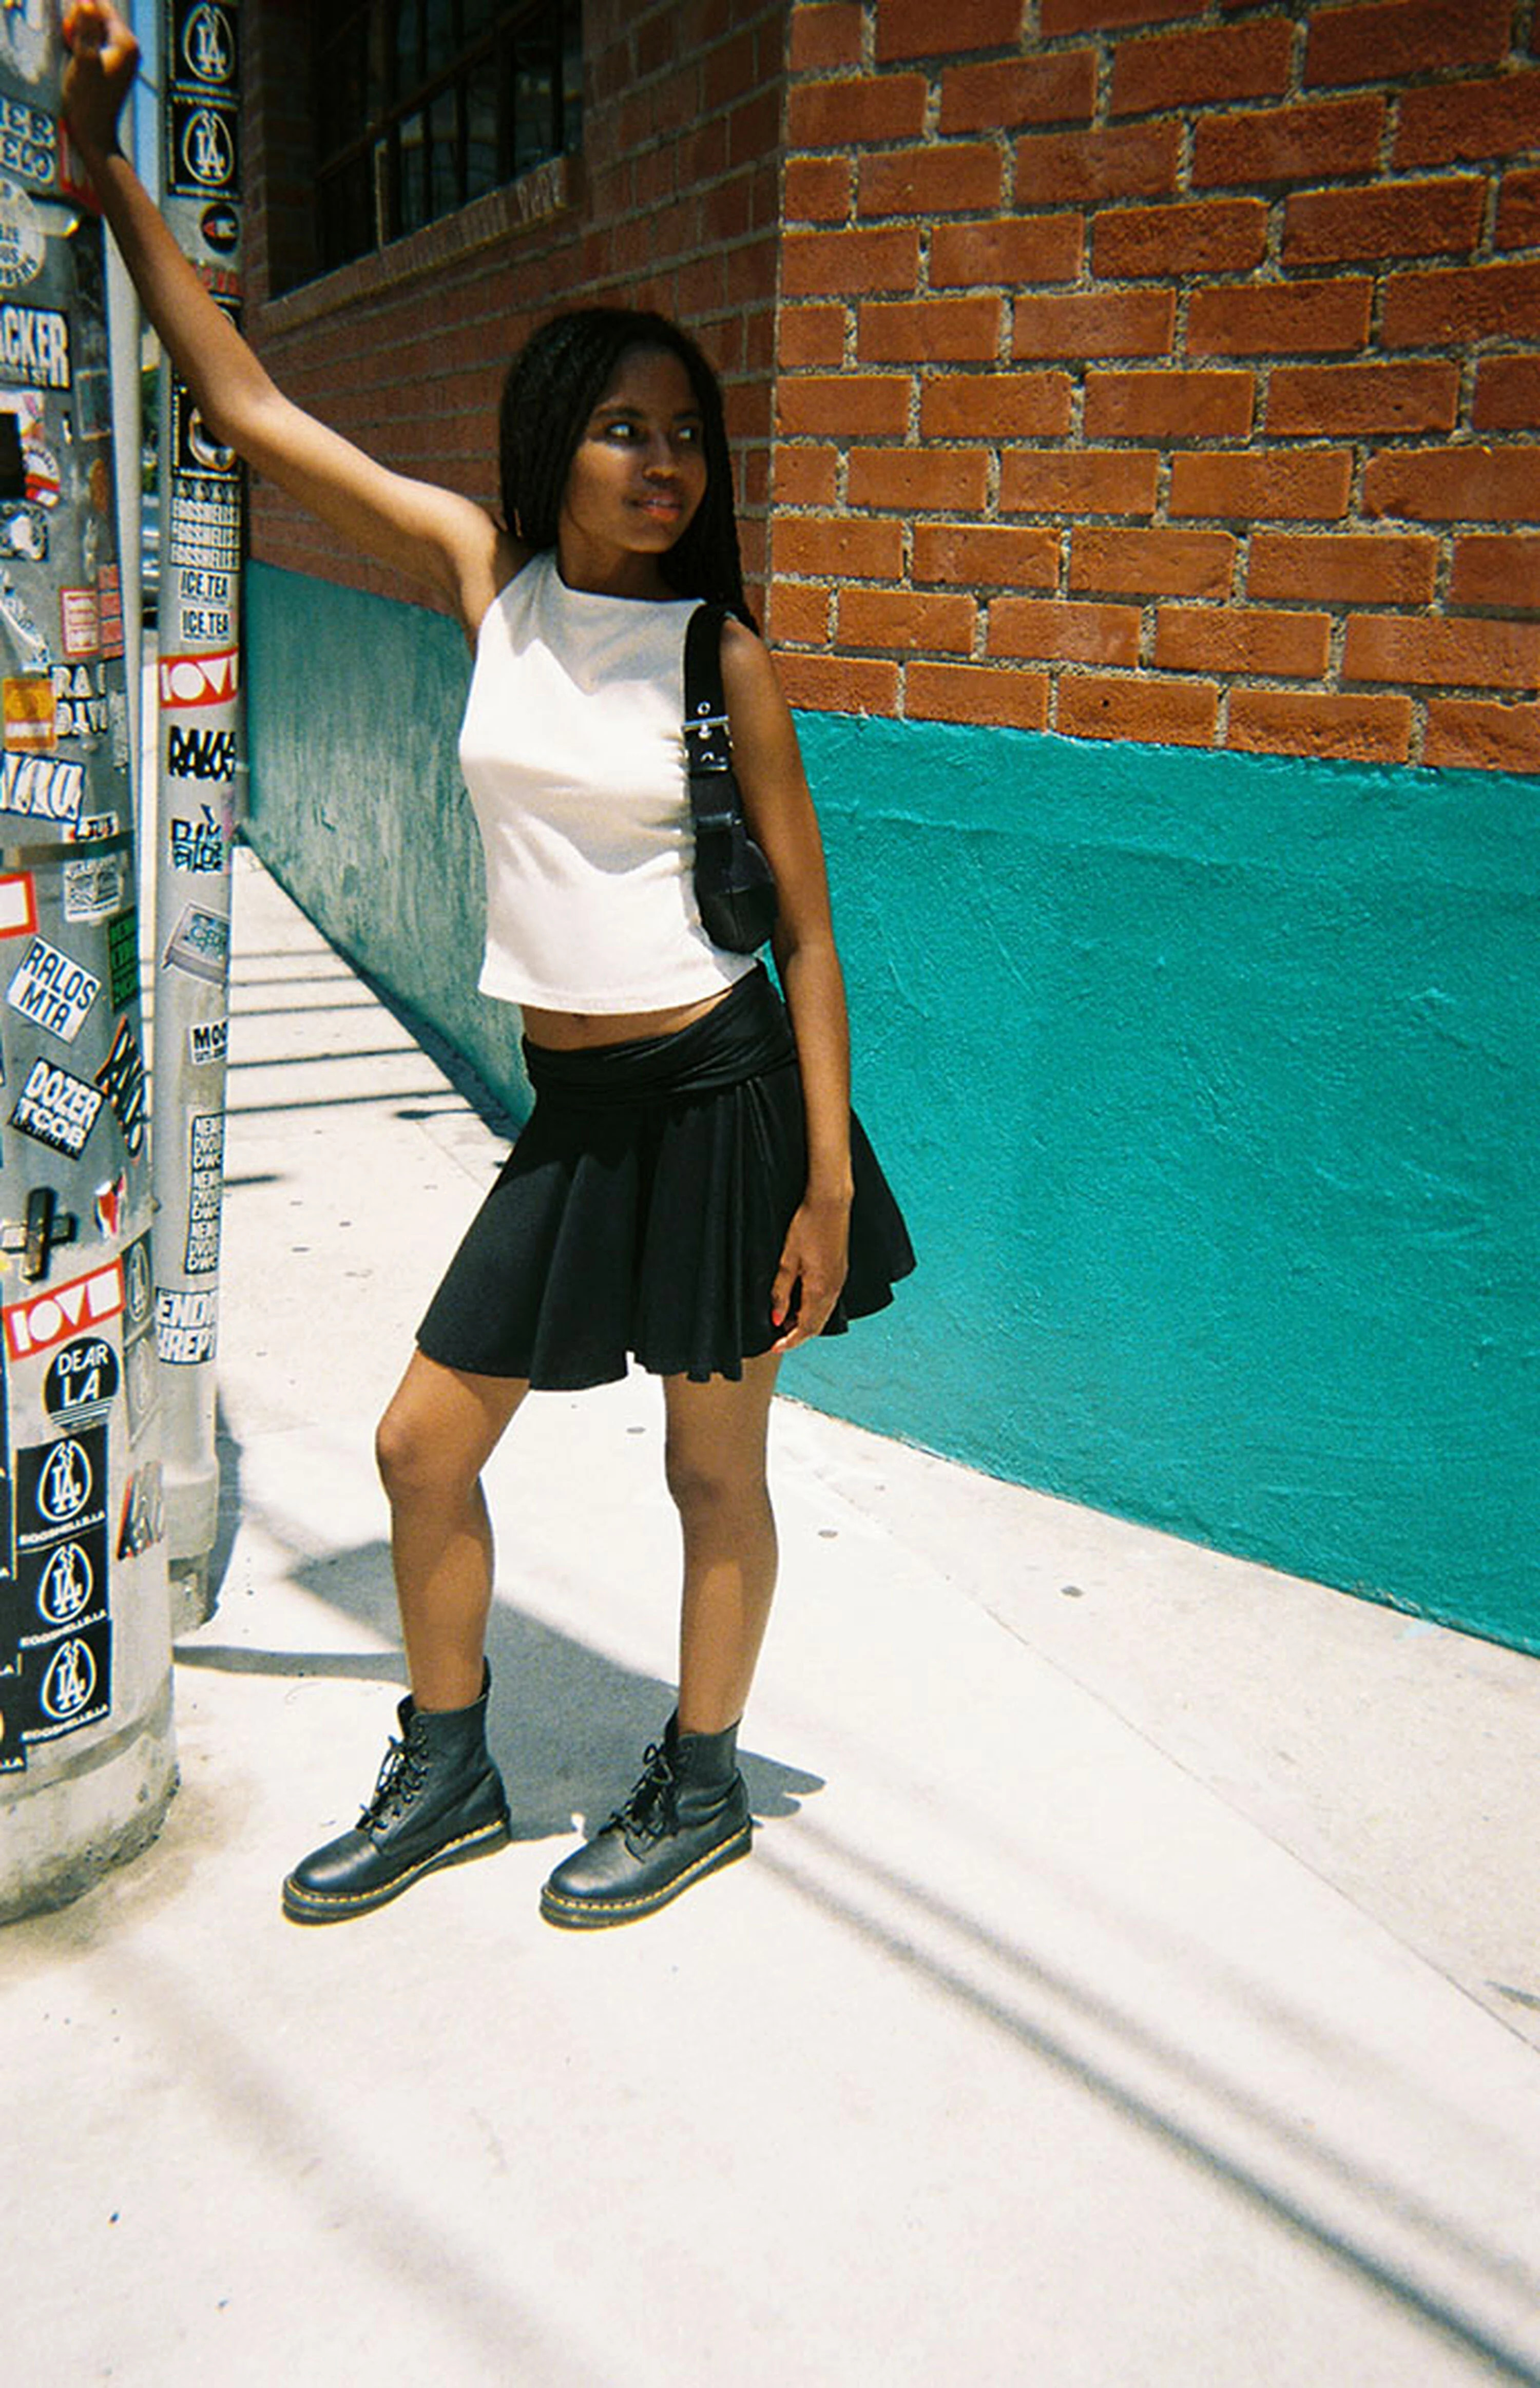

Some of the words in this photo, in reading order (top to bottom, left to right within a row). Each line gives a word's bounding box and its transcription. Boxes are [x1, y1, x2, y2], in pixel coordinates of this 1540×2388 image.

[0, 303, 70, 389] CKER
[182, 570, 204, 596] ICE
[207, 574, 227, 598] TEA
[183, 610, 206, 633] ICE
[208, 611, 229, 634] TEA
[24, 941, 97, 1011] RALOS
[20, 981, 71, 1033] MTA
[25, 1060, 102, 1131] DOZER
[12, 1097, 86, 1149] TCOB
[56, 1343, 109, 1377] DEAR
[63, 1369, 101, 1408] LA
[51, 1463, 82, 1514] LA
[53, 1567, 83, 1616] LA
[55, 1663, 86, 1711] LA
